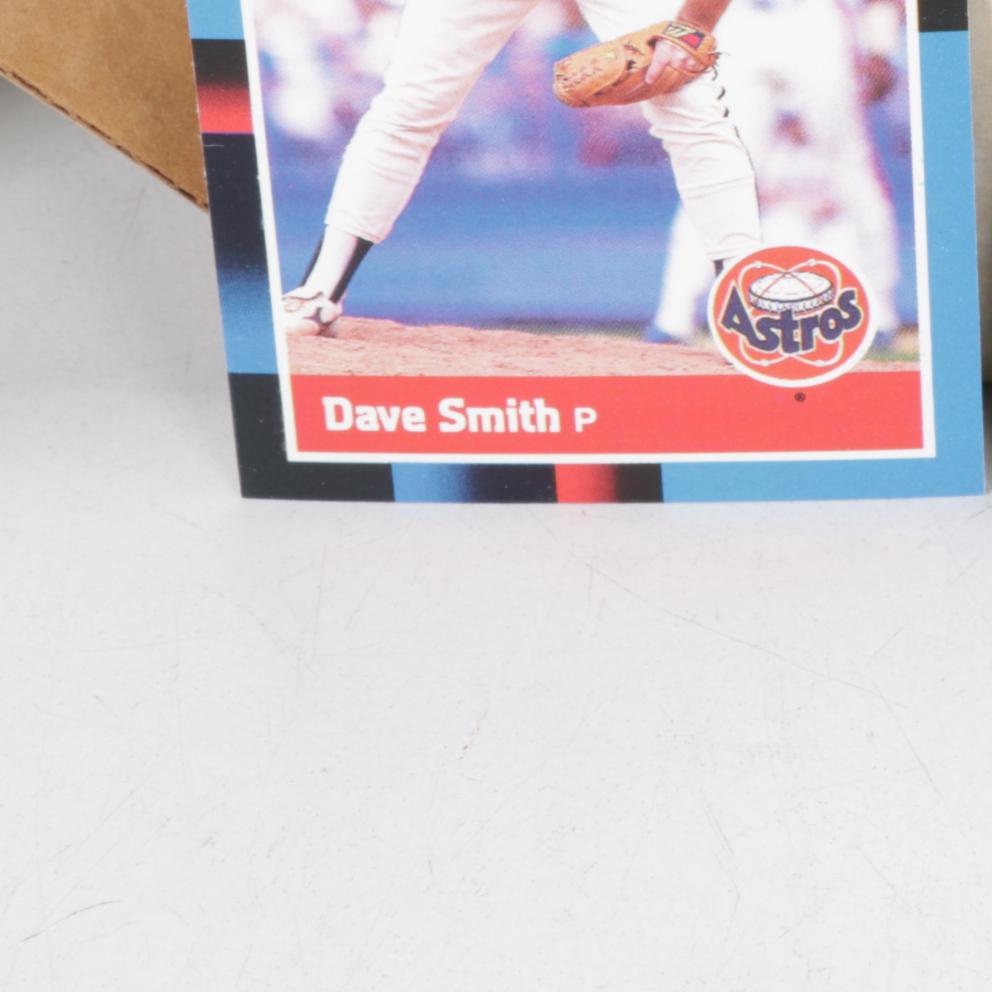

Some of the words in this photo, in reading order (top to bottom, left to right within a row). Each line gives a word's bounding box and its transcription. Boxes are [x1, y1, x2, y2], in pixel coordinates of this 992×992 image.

[720, 285, 863, 354] Astros
[322, 395, 427, 432] Dave
[437, 398, 561, 433] Smith
[574, 407, 598, 433] P
